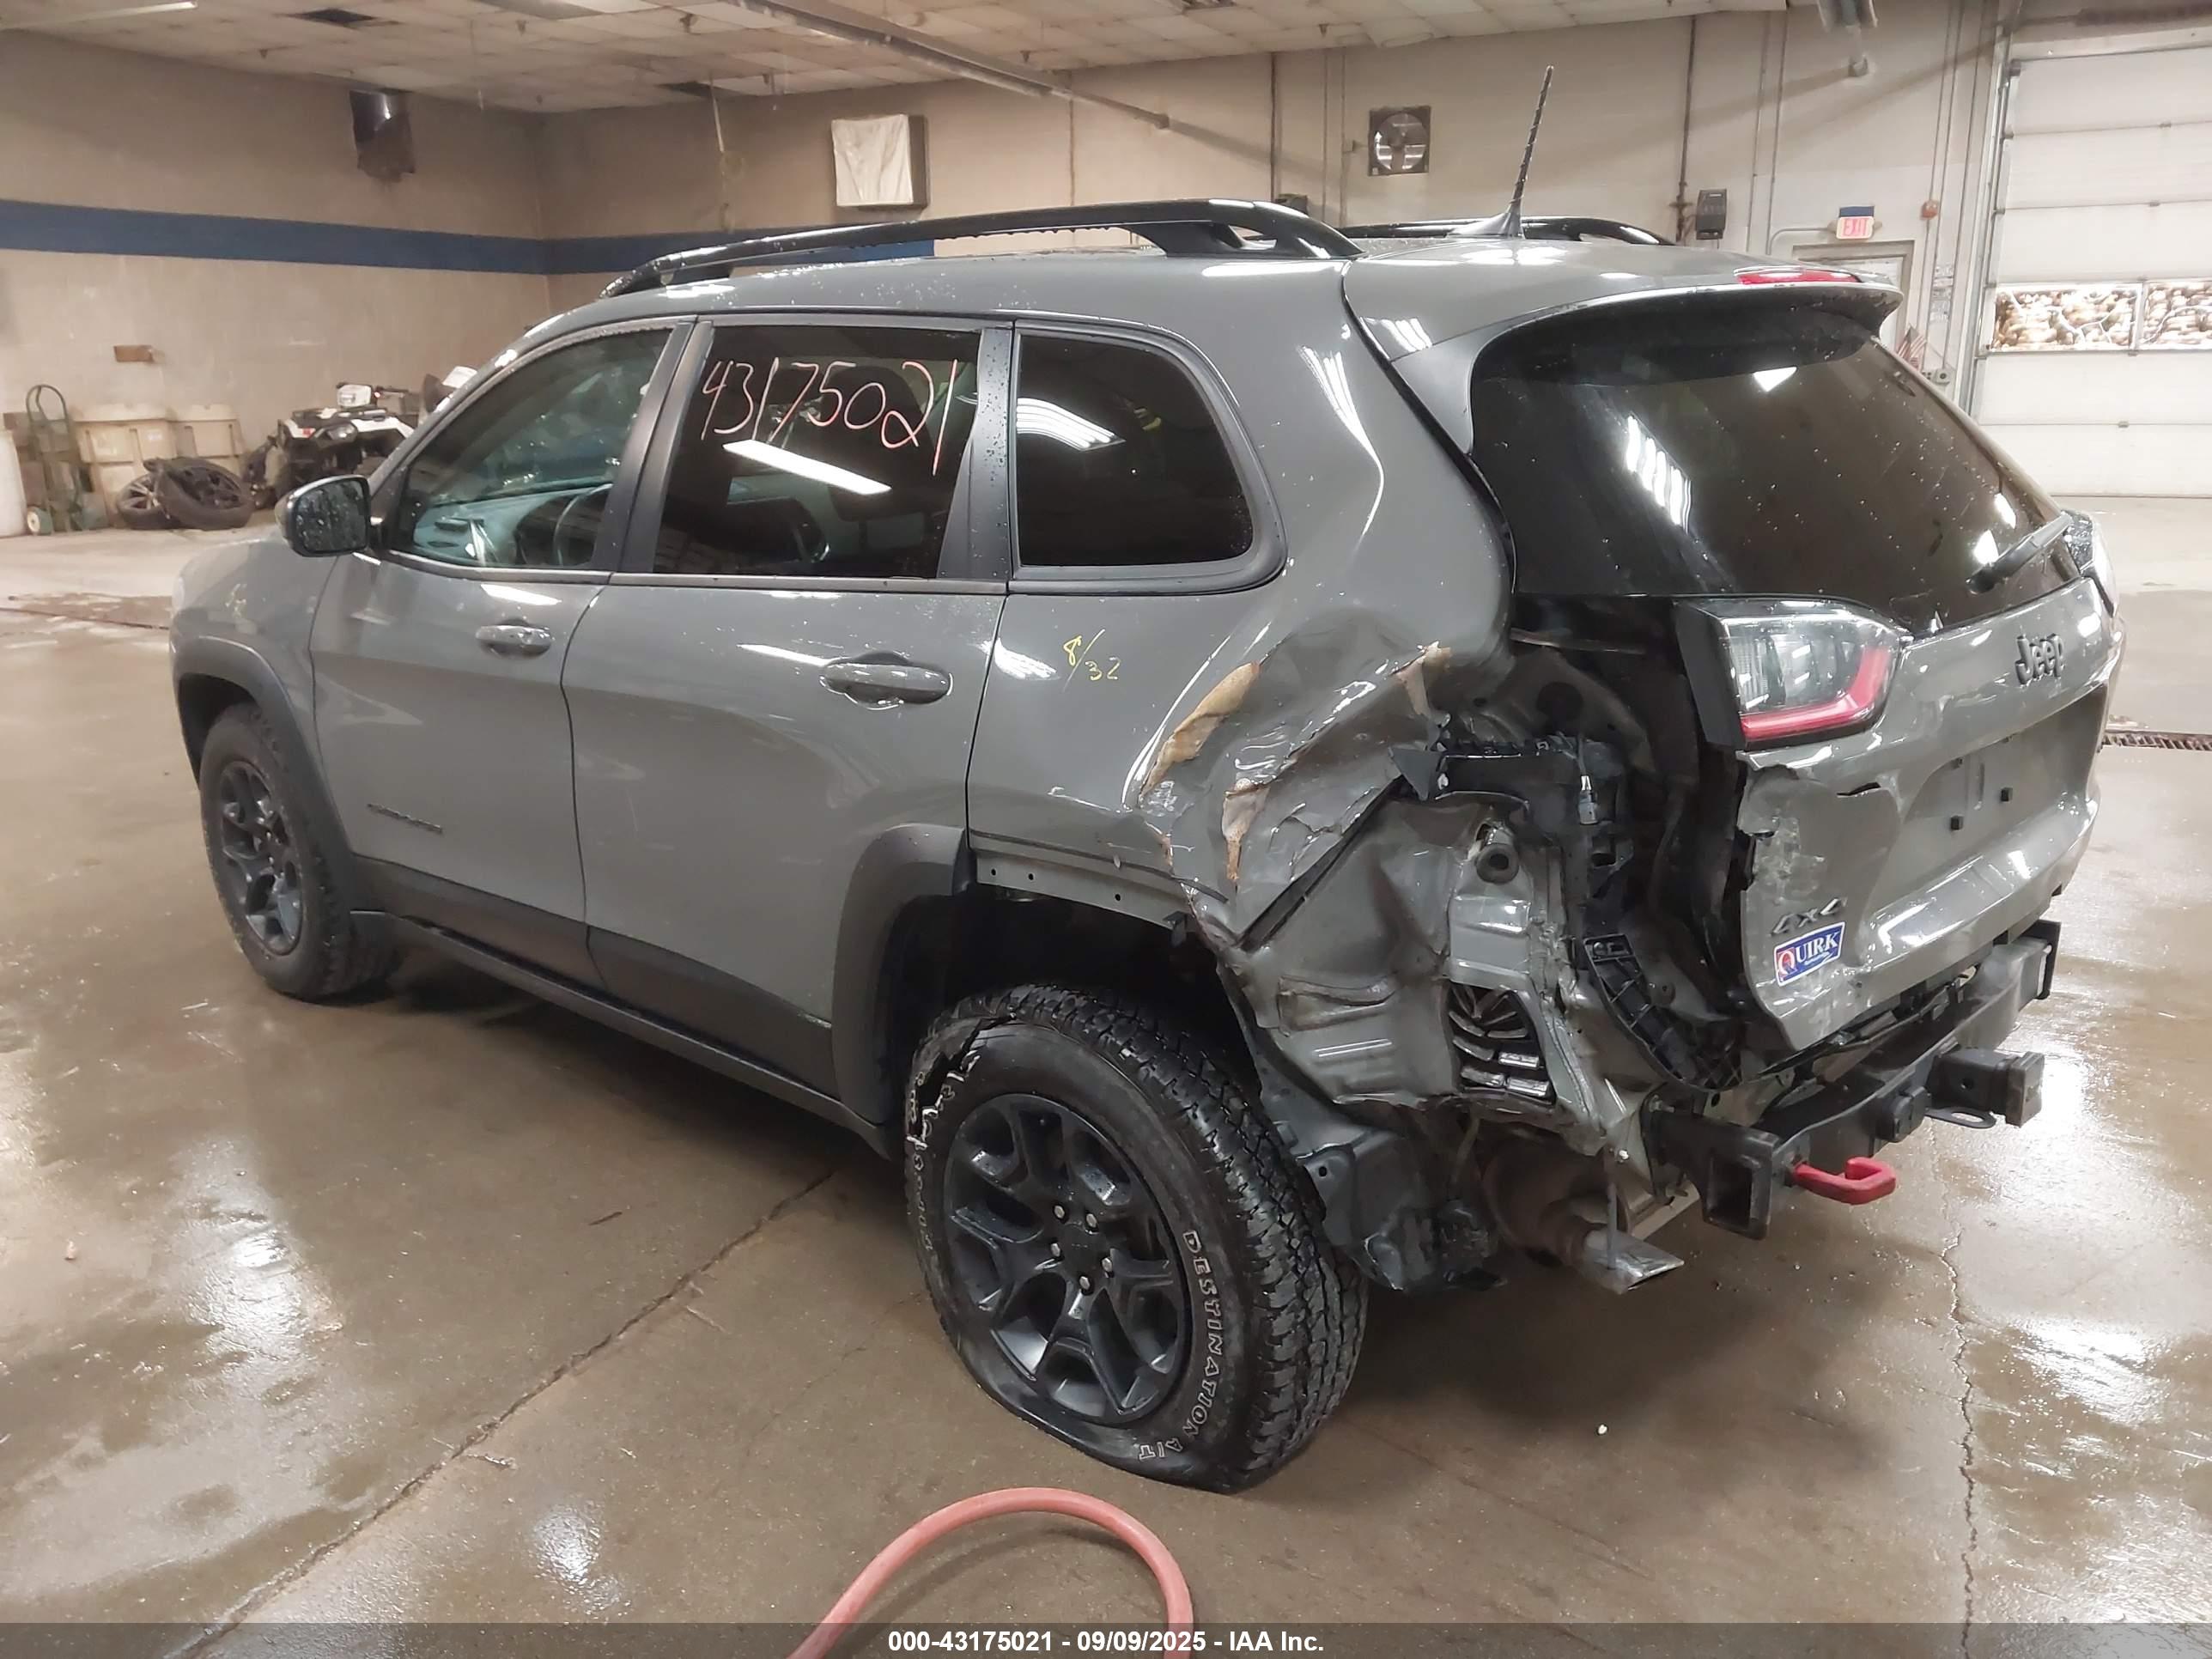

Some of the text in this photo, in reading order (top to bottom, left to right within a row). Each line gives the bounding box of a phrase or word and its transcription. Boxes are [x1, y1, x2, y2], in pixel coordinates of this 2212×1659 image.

[1842, 217, 1869, 237] EXIT
[700, 356, 958, 477] 43175021
[2014, 633, 2064, 686] Jeep
[1777, 931, 1840, 976] QUIRK
[1182, 1229, 1224, 1439] DESTINATION
